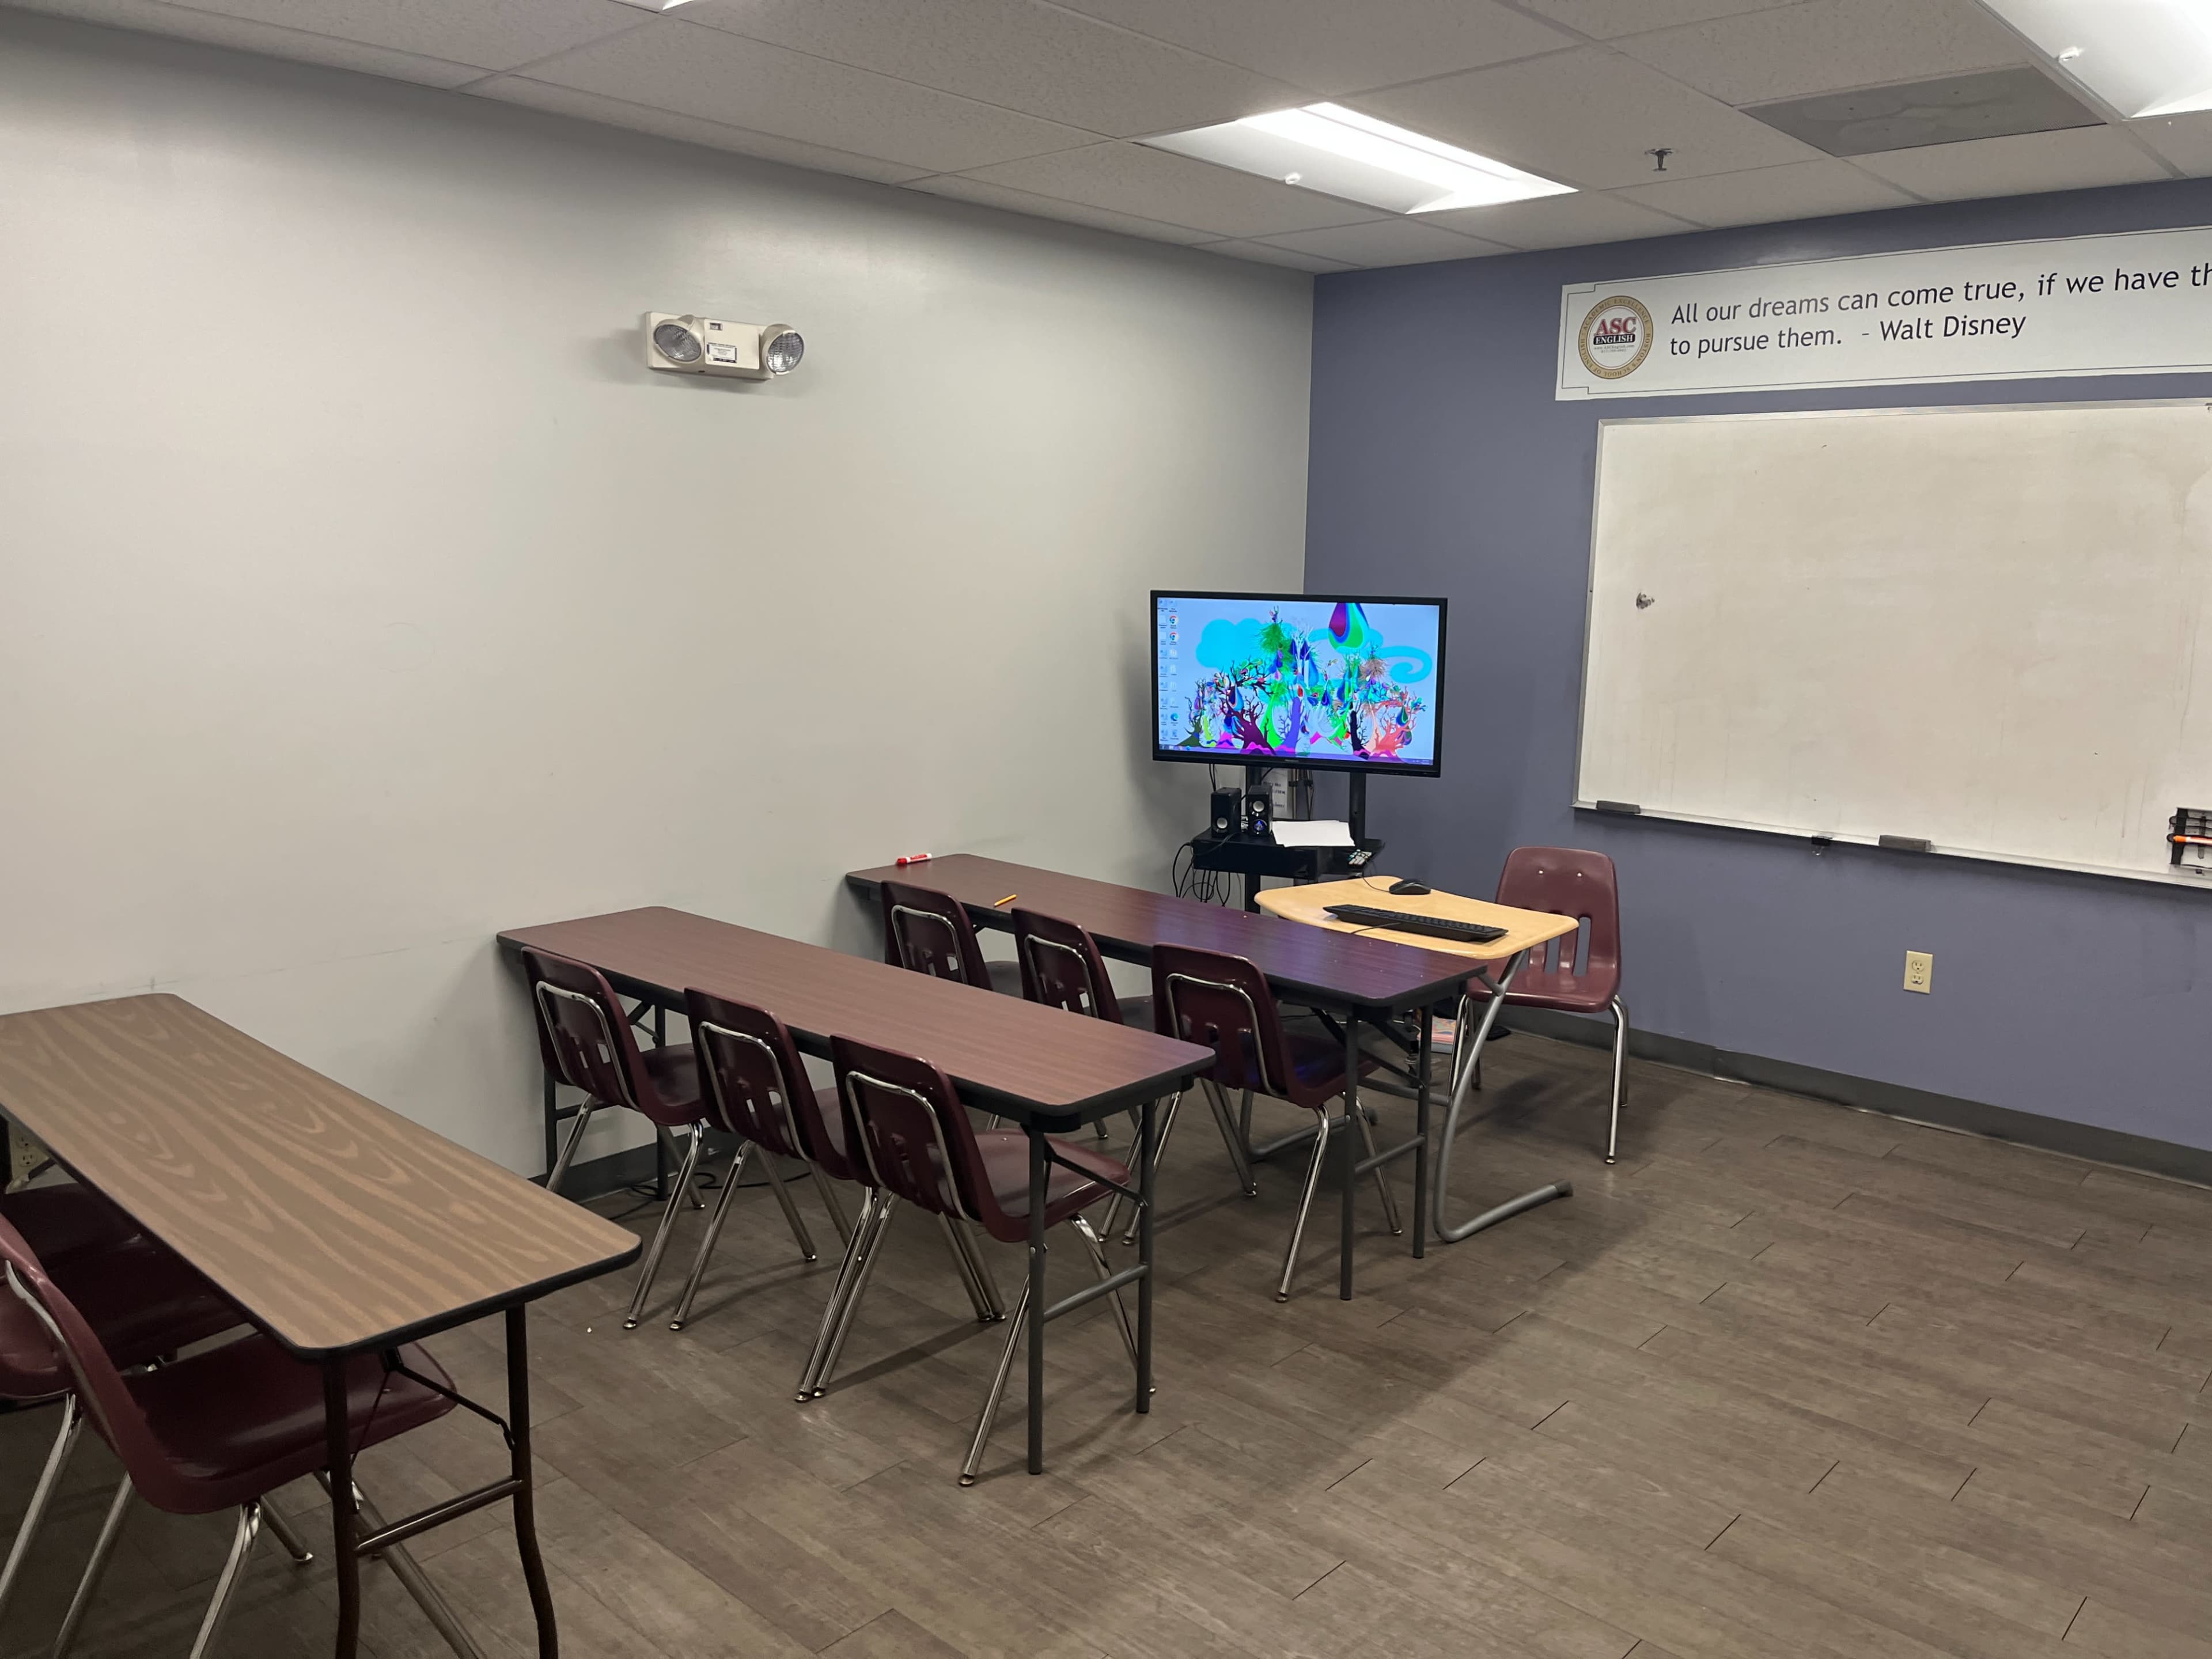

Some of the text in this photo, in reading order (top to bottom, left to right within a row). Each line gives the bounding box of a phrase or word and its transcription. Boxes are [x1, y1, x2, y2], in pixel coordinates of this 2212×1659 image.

[1671, 302, 1698, 324] All
[1706, 304, 1741, 321] our
[1749, 296, 1829, 318] dreams
[1838, 293, 1878, 310] can
[1888, 287, 1953, 307] come
[1964, 282, 2024, 302] true,
[2038, 272, 2058, 296] if
[2066, 275, 2104, 294] we
[2115, 268, 2179, 291] have
[1583, 301, 1611, 329] ACADEMIC
[1594, 316, 1637, 336] ASC
[1595, 335, 1633, 344] ENGLISH
[1671, 338, 1690, 355] to
[1698, 335, 1768, 359] pursue
[1778, 327, 1842, 348] them.
[1880, 317, 1933, 341] Walt
[1944, 315, 2027, 339] Disney
[1580, 338, 1594, 369] ENGLISH
[1604, 367, 1631, 377] SCHOOL
